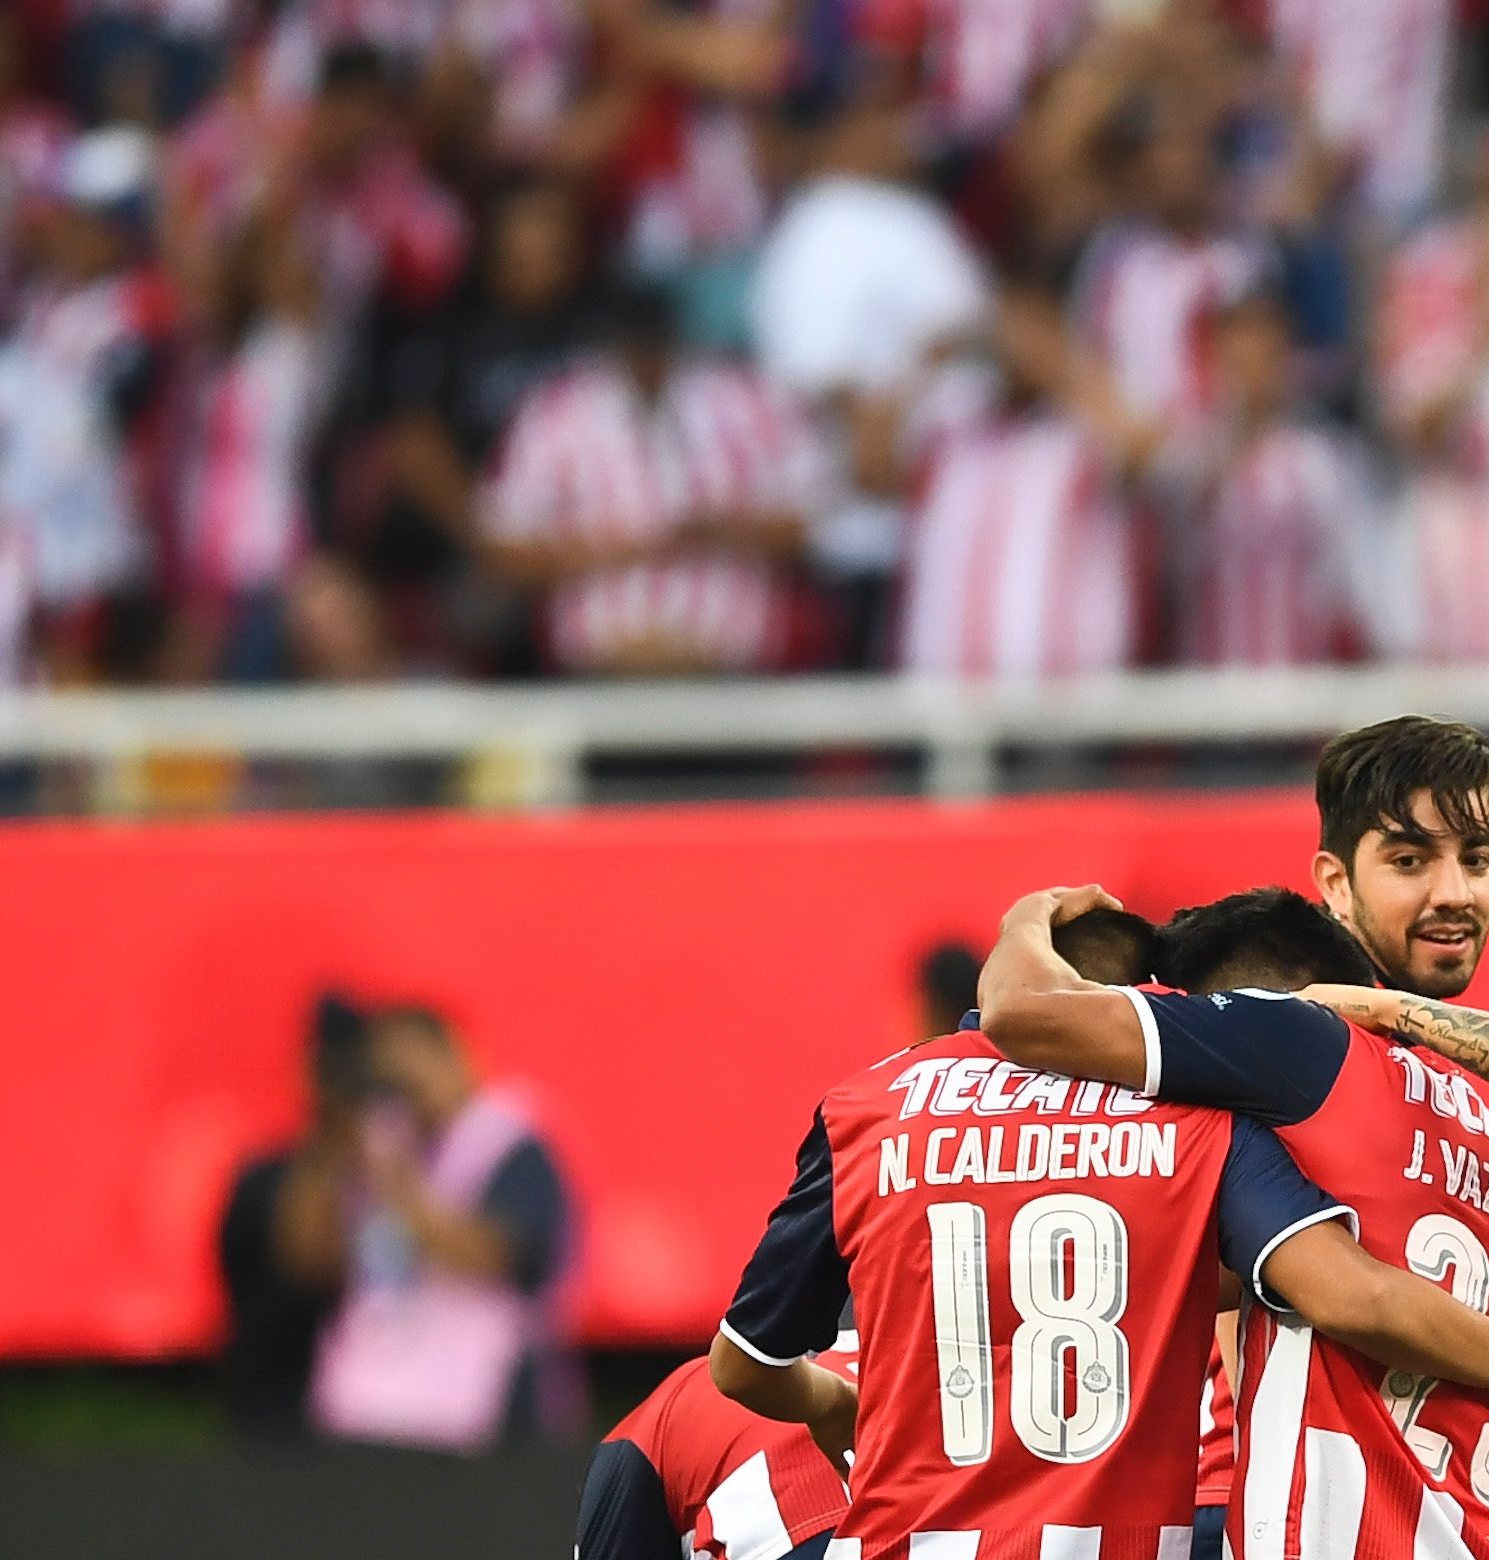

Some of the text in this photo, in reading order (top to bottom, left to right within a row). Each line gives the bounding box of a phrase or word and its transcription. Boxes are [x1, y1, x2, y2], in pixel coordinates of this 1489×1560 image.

[878, 1122, 1177, 1197] N. CALDERON
[1403, 1129, 1434, 1185] J.
[926, 1193, 1130, 1467] 18
